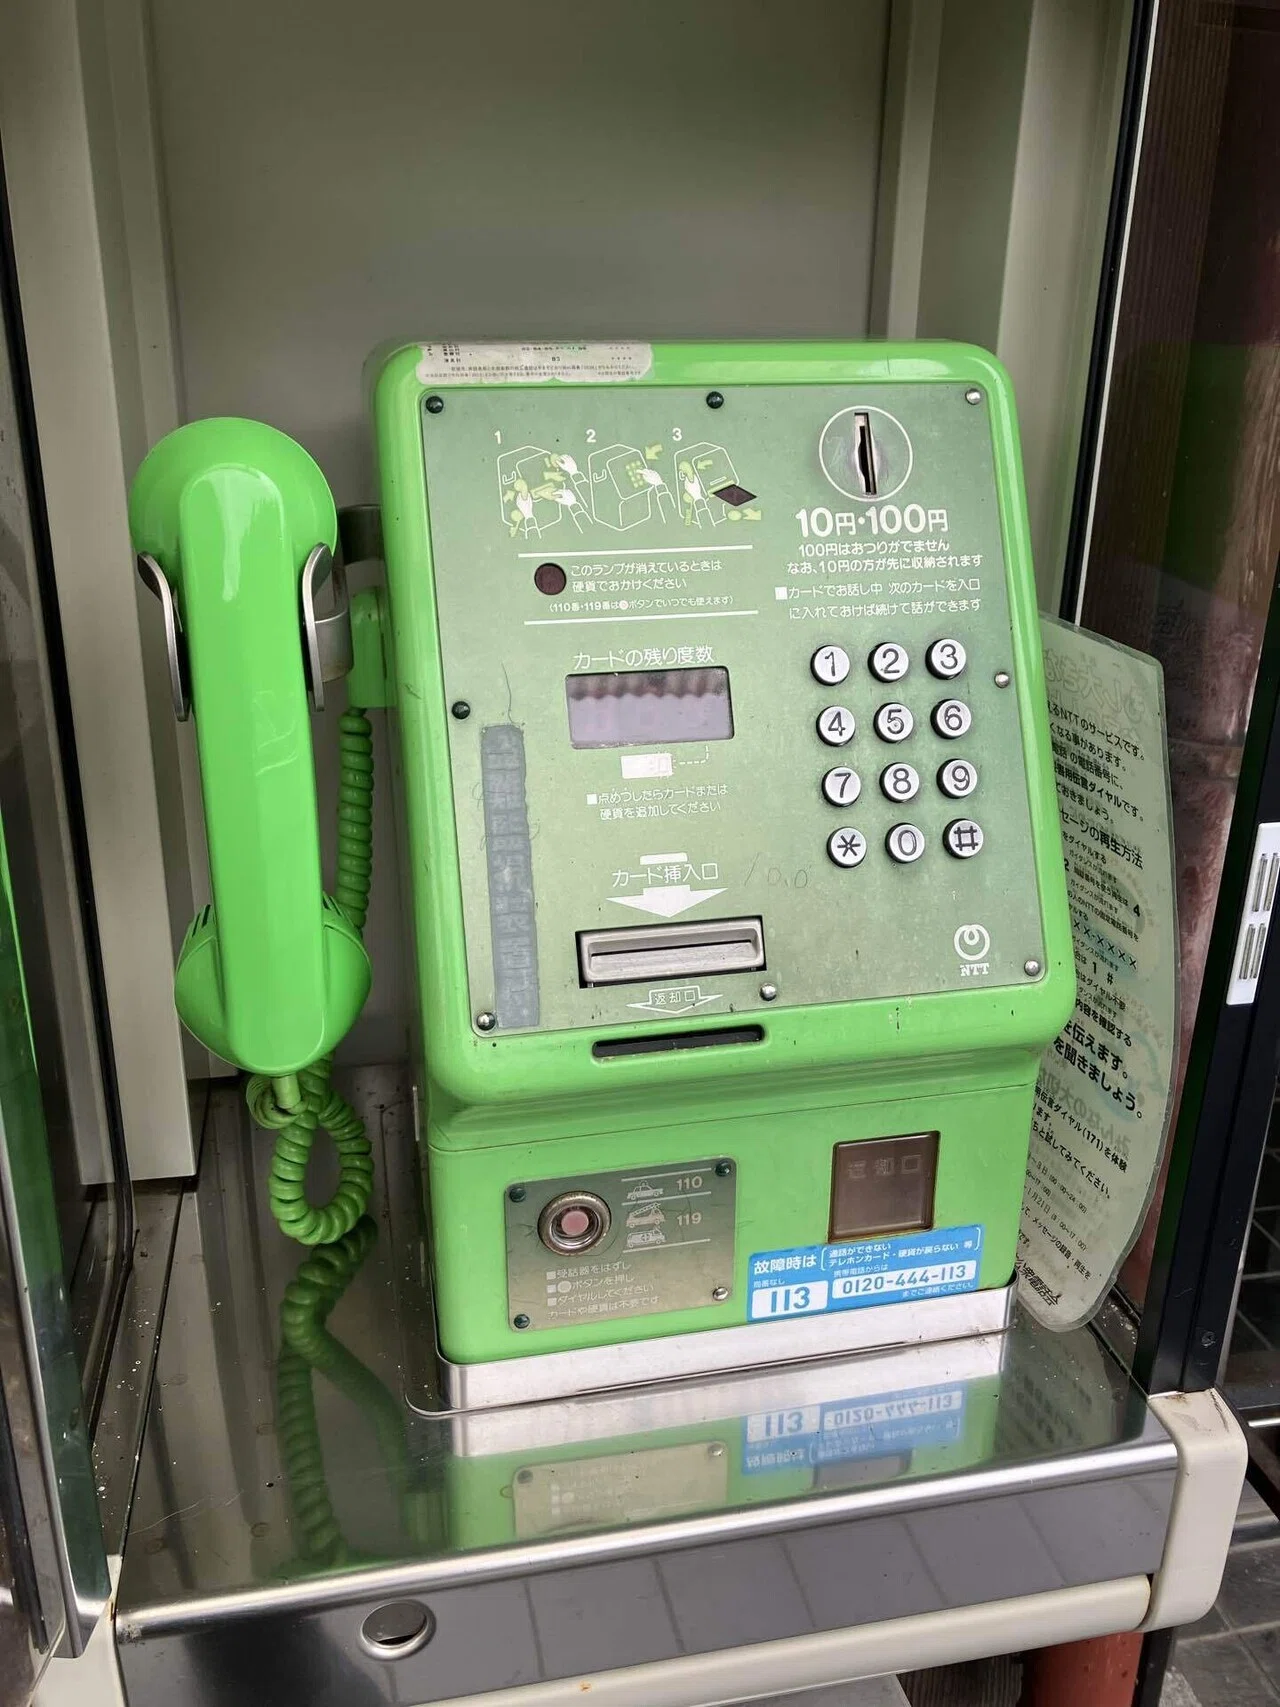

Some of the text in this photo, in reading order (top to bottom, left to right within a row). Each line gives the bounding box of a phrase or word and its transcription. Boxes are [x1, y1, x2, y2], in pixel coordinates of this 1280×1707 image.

[494, 427, 682, 444] 1 2 3
[799, 539, 950, 557] 100円はおつりがでません
[571, 560, 723, 576] このランプが消えているときは
[787, 555, 983, 575] なお、10円の方が先に収納されます
[572, 578, 687, 593] 硬貨でおかけください
[789, 578, 981, 599] カードでお話し中 次のカードを入口
[789, 599, 982, 620] に入れておけば続けて話ができます
[573, 646, 714, 670] カードの残り度数
[825, 643, 958, 676] 1 2 3
[828, 705, 962, 736] 4 5 6
[834, 765, 970, 798] 7 8 9
[598, 784, 729, 805] 点めつしたらカードまたは
[600, 802, 722, 820] 硬貨を追加してください
[897, 829, 917, 856] 0
[953, 825, 979, 851] #
[612, 862, 719, 888] カード挿入口
[1133, 904, 1141, 917] 4
[960, 963, 989, 976] NTT
[1093, 961, 1098, 975] 1
[654, 990, 696, 1005] 返却口
[676, 1176, 703, 1191] 110
[677, 1212, 702, 1227] 119
[753, 1255, 817, 1275] 故障時は
[842, 1264, 967, 1295] 0120-444-113
[770, 1286, 811, 1313] 113
